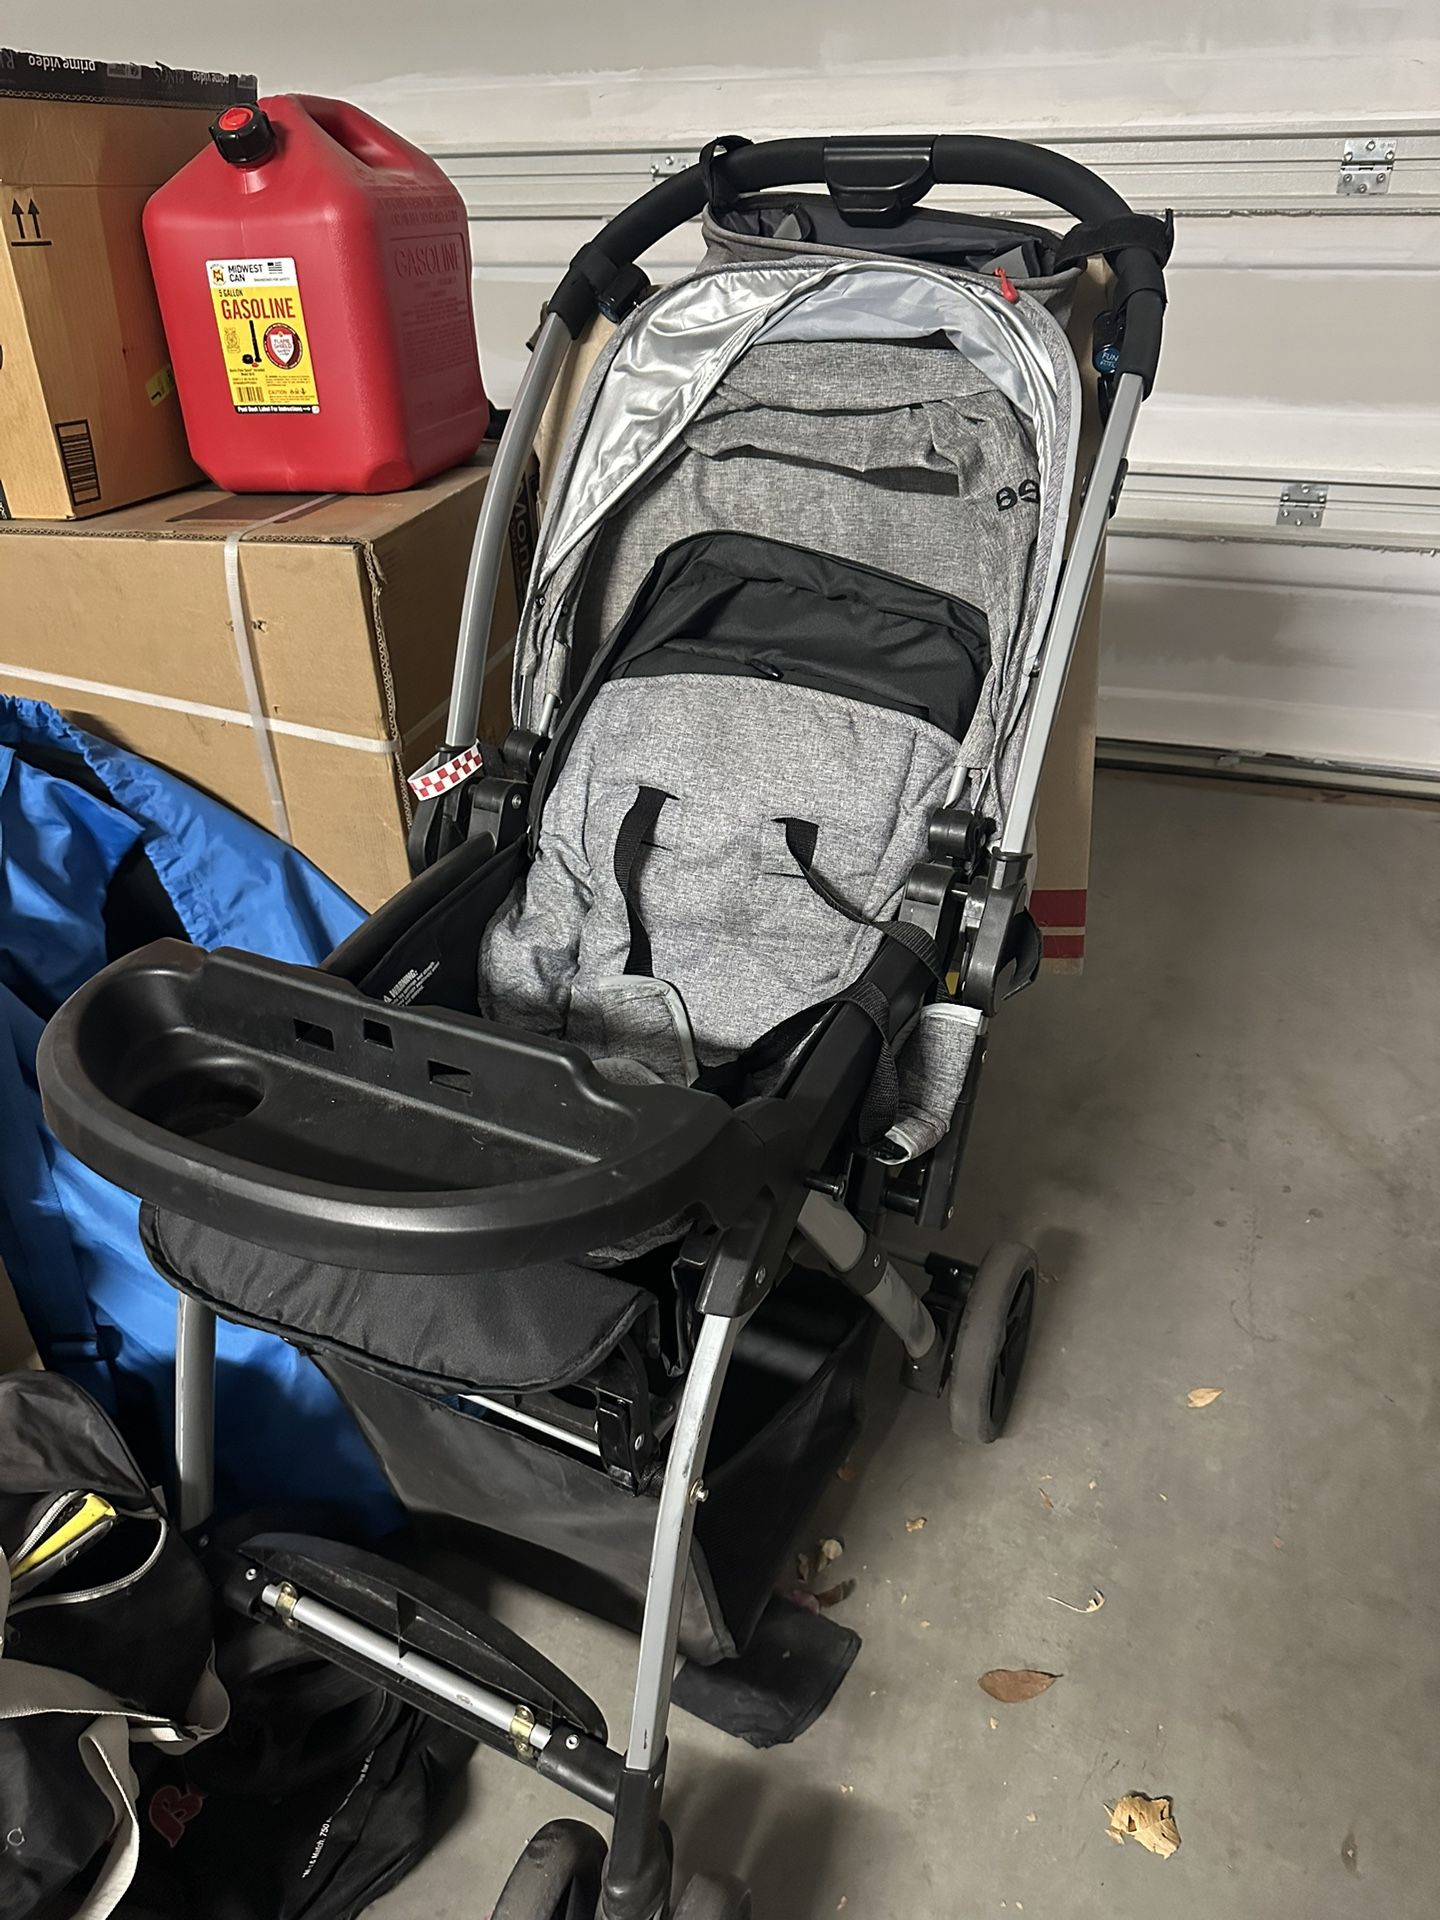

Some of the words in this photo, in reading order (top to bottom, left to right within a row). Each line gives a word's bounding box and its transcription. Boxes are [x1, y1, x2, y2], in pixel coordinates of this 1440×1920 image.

[28, 54, 61, 71] video
[63, 59, 96, 74] prime
[192, 71, 211, 85] video
[228, 264, 263, 273] MIDWEST
[229, 273, 246, 283] CAN
[218, 289, 223, 298] 5
[223, 288, 244, 298] GALLON
[220, 297, 296, 320] GASOLINE
[1102, 352, 1120, 362] FUN
[319, 1823, 330, 1837] 750
